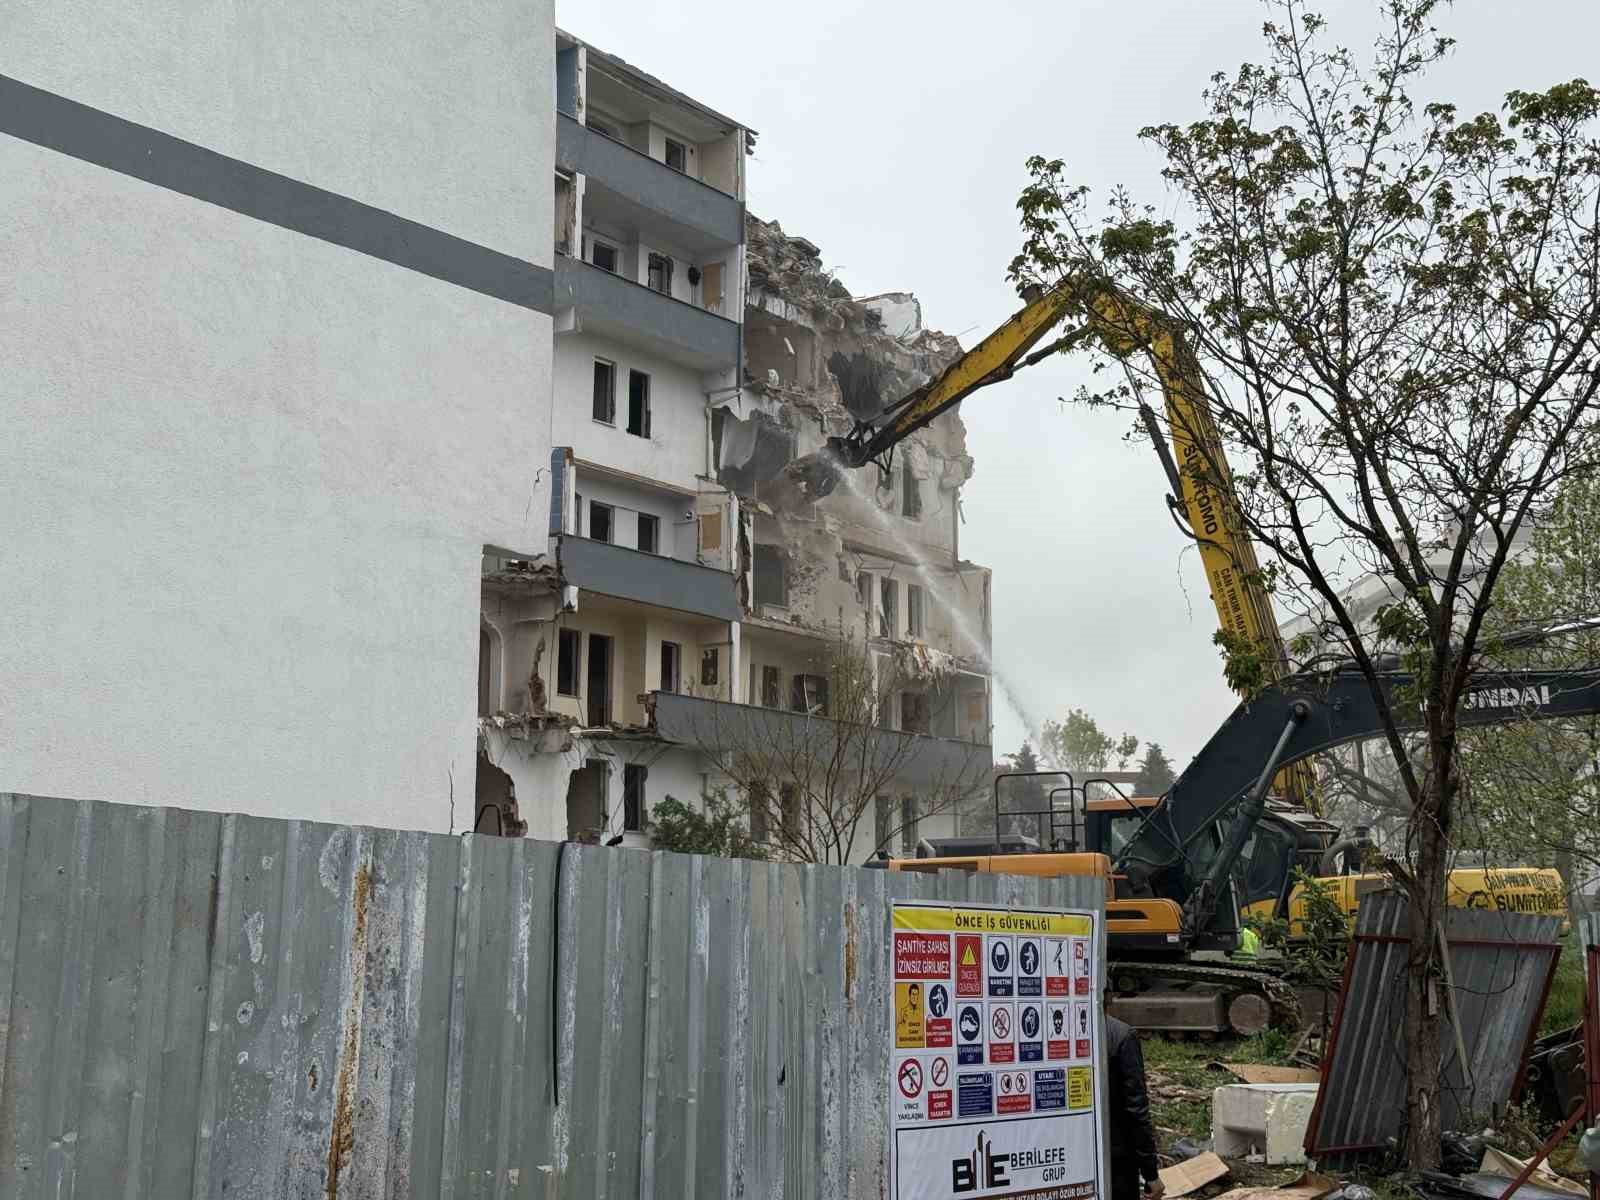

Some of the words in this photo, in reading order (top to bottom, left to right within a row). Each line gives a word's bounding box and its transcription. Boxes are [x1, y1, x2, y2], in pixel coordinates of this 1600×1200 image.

[955, 913, 982, 928] ÖNCE
[986, 915, 996, 929] İŞ
[1000, 917, 1050, 931] GÜVENLİĞİ
[897, 937, 926, 956] ŞANTİYE
[927, 940, 949, 953] SAHASI
[897, 958, 922, 974] İZİNSİZ
[923, 958, 949, 975] GİRİLMEZ
[1010, 1147, 1065, 1168] BERİLEFE
[1042, 1167, 1066, 1182] GRUP
